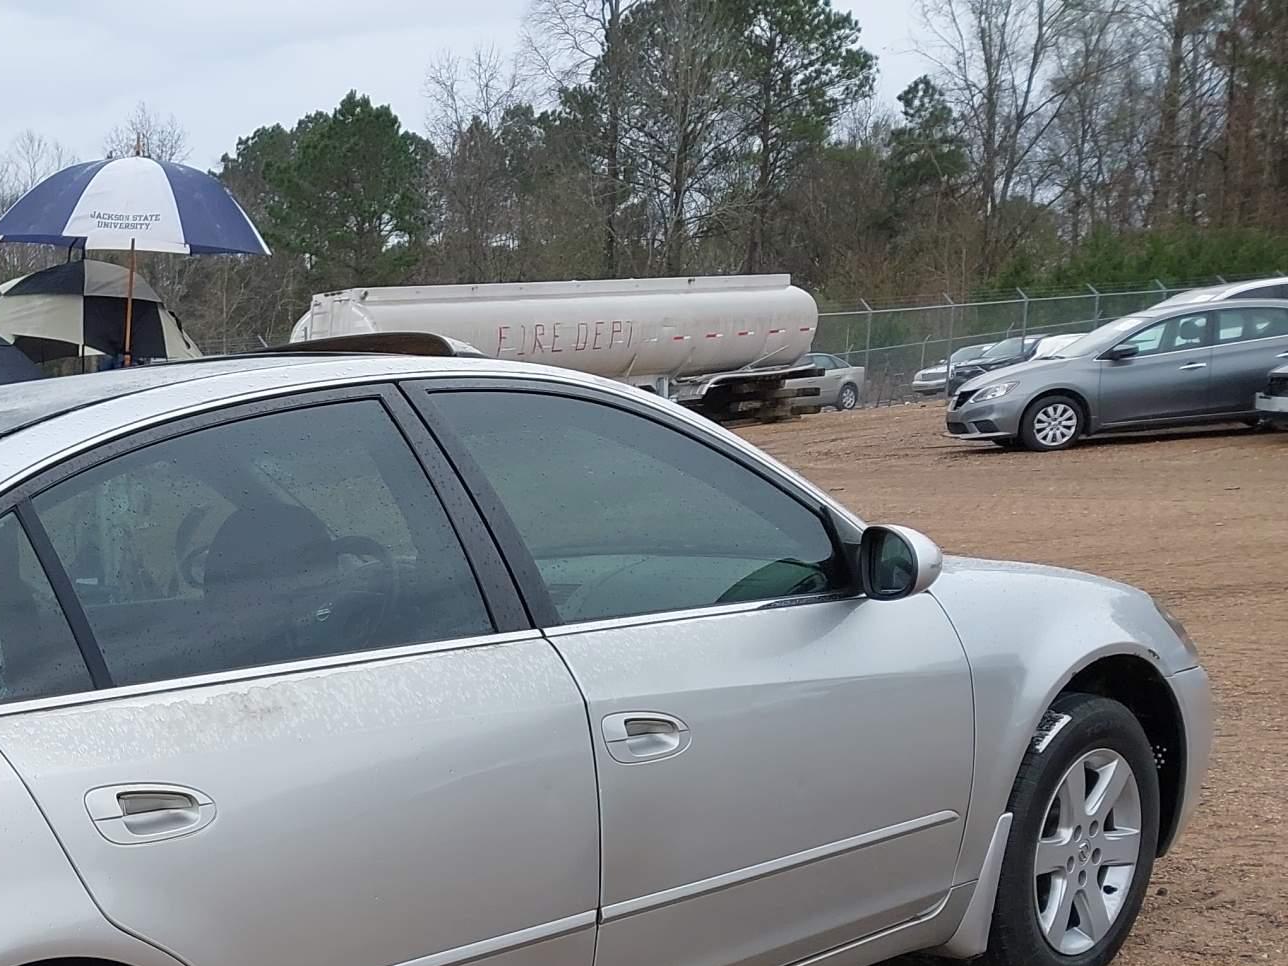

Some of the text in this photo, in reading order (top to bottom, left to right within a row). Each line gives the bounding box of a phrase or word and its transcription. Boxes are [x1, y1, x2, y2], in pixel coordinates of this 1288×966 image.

[90, 211, 161, 222] JACKSON STATE
[97, 220, 151, 230] UNIVERSITY
[496, 320, 633, 357] FIRE DEPT
